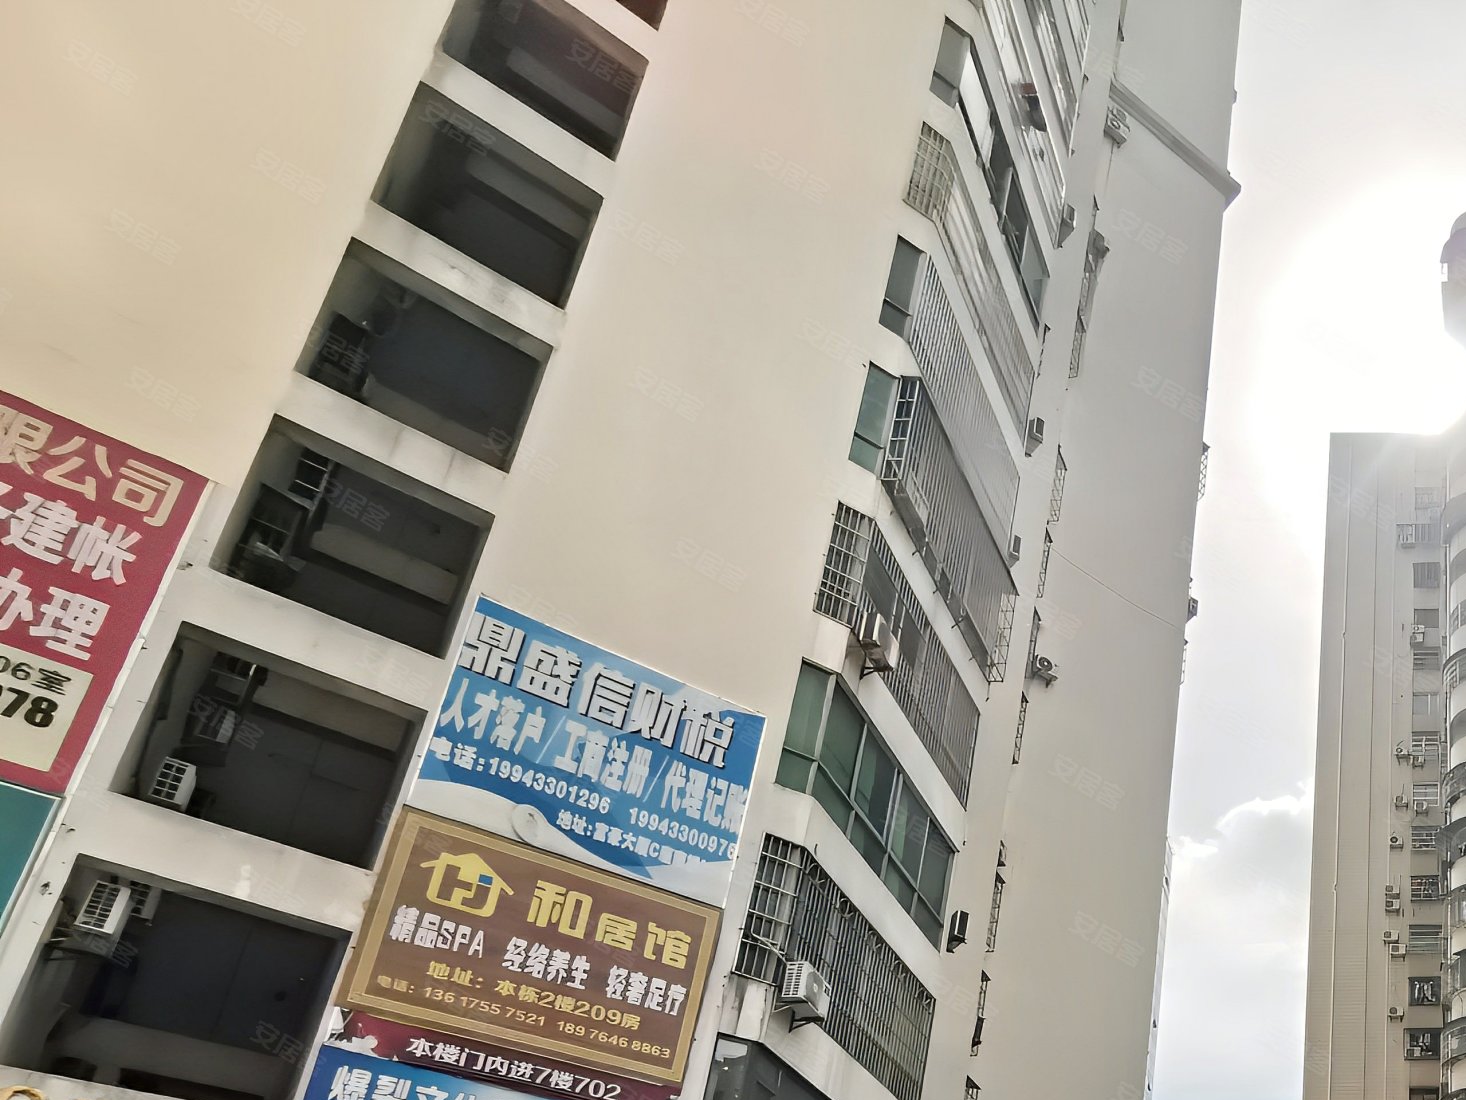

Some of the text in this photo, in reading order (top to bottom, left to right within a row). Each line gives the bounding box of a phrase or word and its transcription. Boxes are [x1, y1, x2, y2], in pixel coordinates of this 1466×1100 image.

[0, 481, 143, 586] 建帐
[458, 613, 736, 769] 鼎盛信财税
[389, 904, 688, 1017] 精品SPA 经络养生 轻奢足疗
[527, 879, 693, 971] 和居馆
